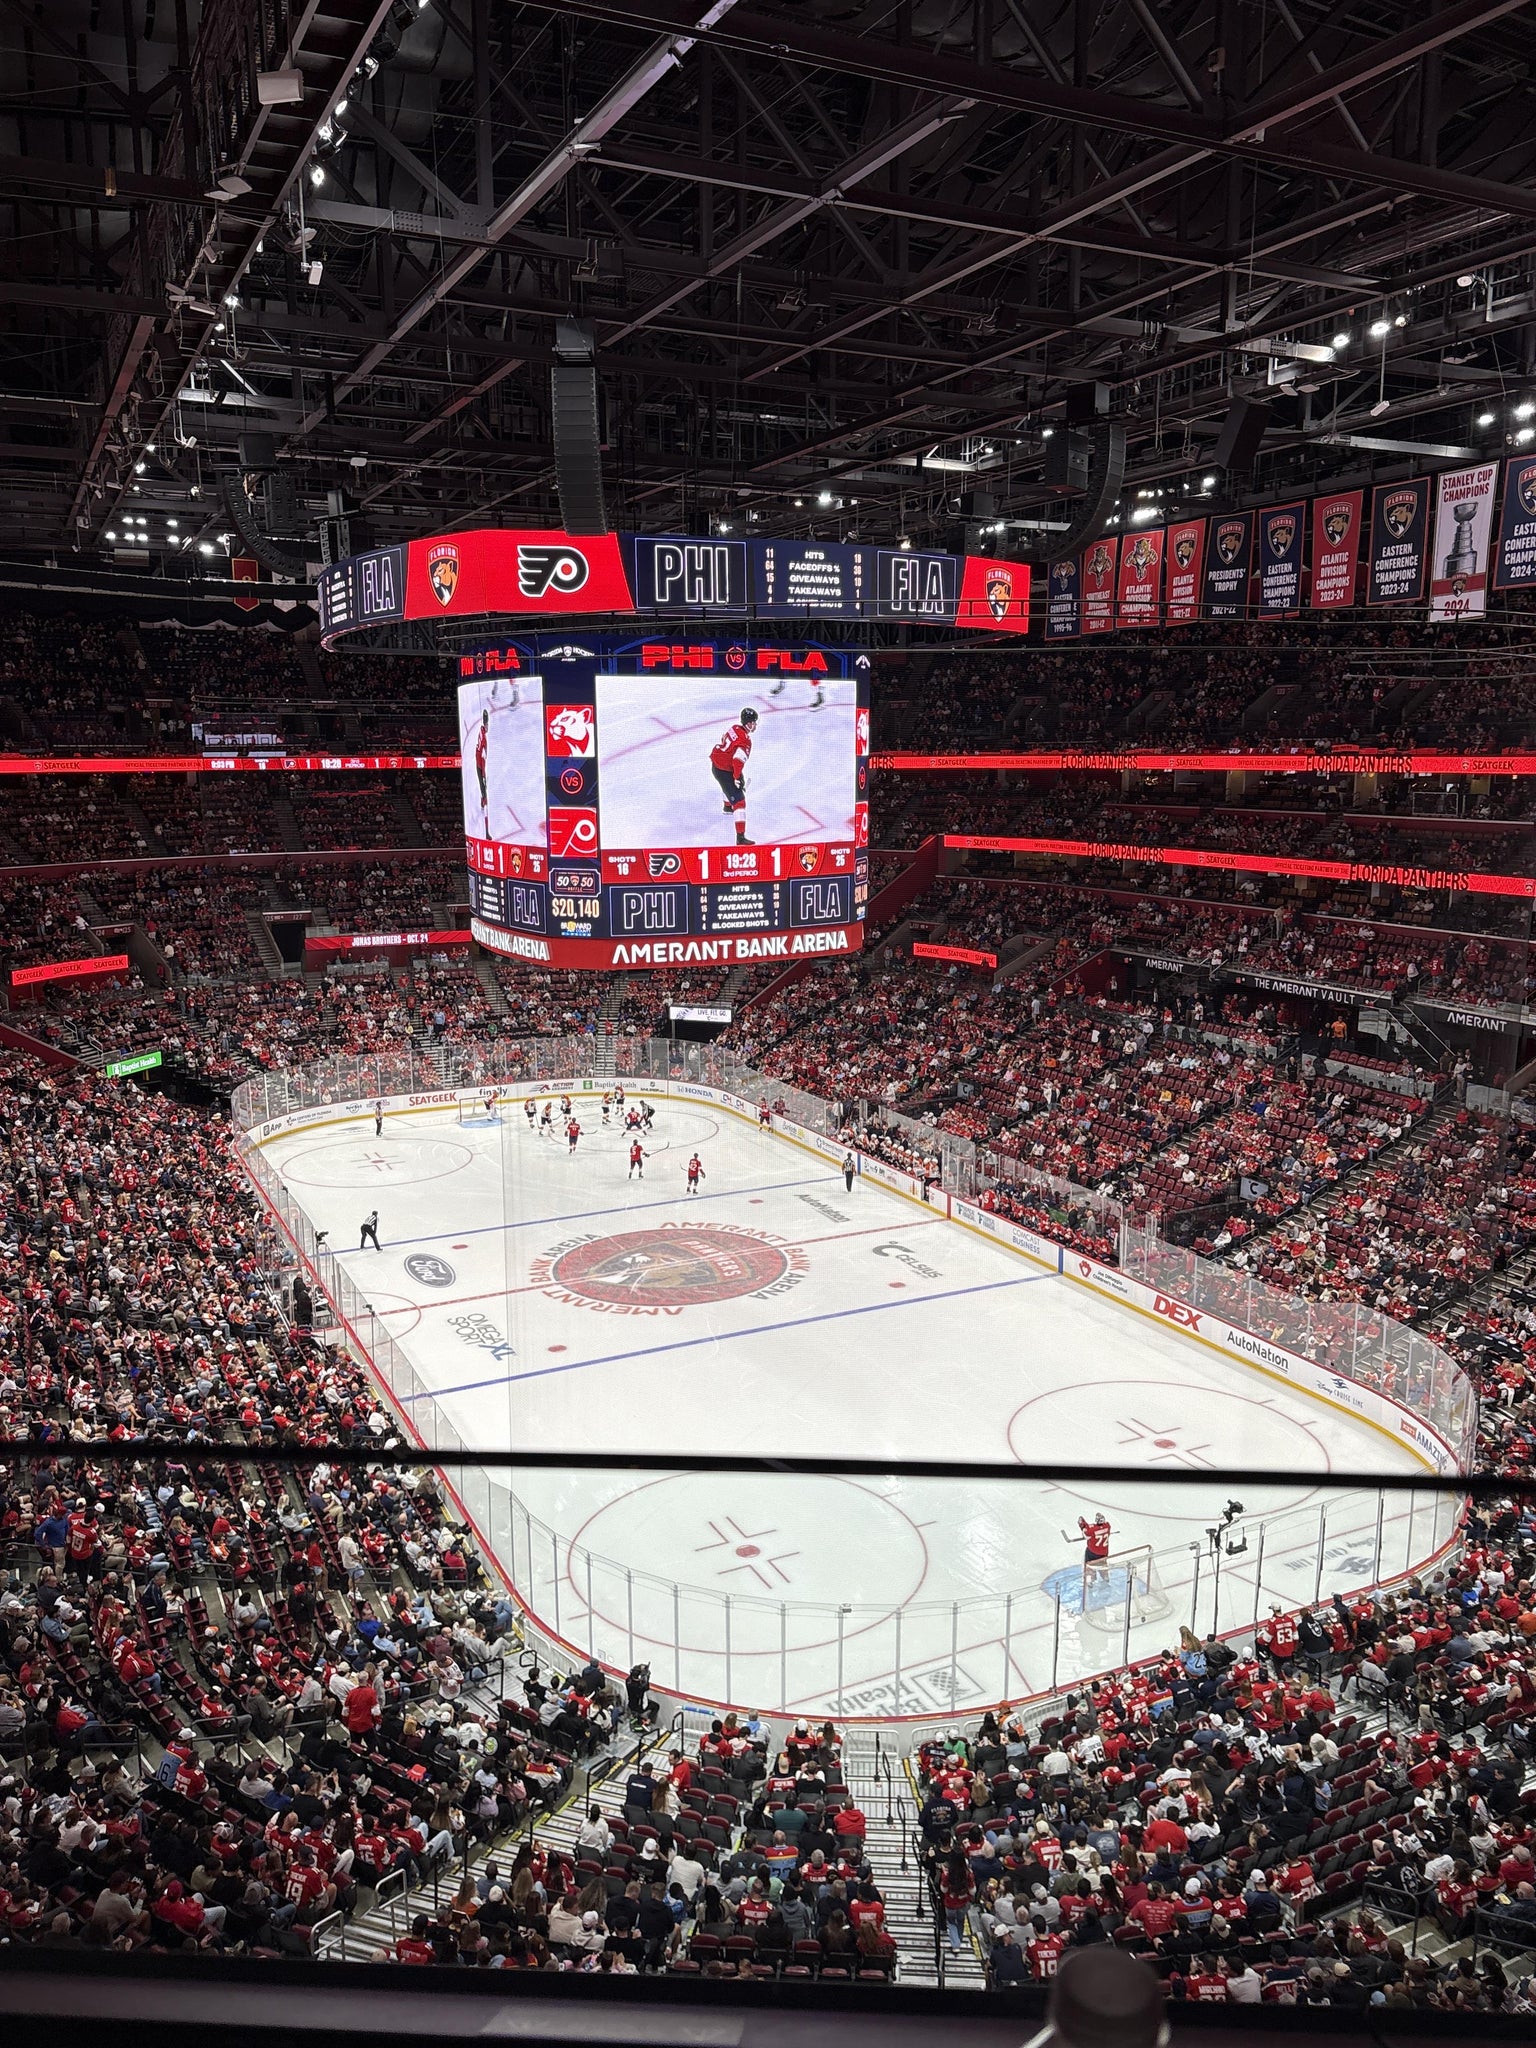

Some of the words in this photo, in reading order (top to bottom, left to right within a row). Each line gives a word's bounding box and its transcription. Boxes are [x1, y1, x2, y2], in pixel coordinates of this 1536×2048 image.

[1443, 473, 1476, 490] STANLEY
[1477, 469, 1493, 482] CUP
[1443, 483, 1490, 503] CHAMPIONS
[804, 551, 825, 561] HITS
[1382, 543, 1413, 558] EASTERN
[1320, 552, 1349, 566] ATLANTIC
[1375, 555, 1419, 571] CONFERENCE
[654, 544, 730, 604] PHI
[789, 562, 833, 573] FACEOFFS
[1208, 568, 1246, 581] PRESIDENTS'
[1267, 562, 1293, 575] EASTERN
[1320, 564, 1348, 578] DIVISION
[789, 574, 840, 585] GIVEAWAYS
[1172, 573, 1195, 586] ATLANTIC
[1262, 573, 1297, 588] CONFERENCE
[1316, 576, 1350, 591] CHAMPIONS
[1375, 568, 1417, 584] CHAMPIONS
[362, 557, 396, 615] FLA
[788, 586, 842, 597] TAKEAWAYS
[891, 557, 944, 614] FLA
[1172, 585, 1194, 598] DIVISION
[1214, 581, 1238, 593] TROPHY
[1263, 585, 1296, 599] CHAMPIONS
[1380, 582, 1410, 596] 2023-24
[1267, 597, 1291, 608] 2022-23
[1320, 590, 1344, 602] 2023-24
[1443, 598, 1470, 617] 2024
[485, 647, 520, 672] FLA
[642, 645, 714, 669] PHI
[729, 653, 742, 664] VS
[756, 648, 829, 672] FLA
[44, 762, 80, 770] SEATGEEK
[1062, 755, 1096, 770] FLORIDA
[1099, 755, 1137, 770] PANTHERS
[1306, 756, 1350, 772] FLORIDA
[1353, 756, 1412, 772] PANTHERS
[1473, 760, 1514, 770] SEATGEEK
[565, 776, 579, 788] VS
[1087, 843, 1119, 858] FLORIDA
[1121, 846, 1164, 862] PANTHERS
[1206, 855, 1236, 865] SEATGEEK
[698, 850, 709, 880] 1
[726, 853, 757, 869] 19:28
[771, 847, 781, 877] 1
[556, 876, 569, 887] 50
[580, 877, 594, 888] 50
[1350, 864, 1398, 885] FLORIDA
[1400, 869, 1469, 890] PANTHERS
[513, 886, 540, 926] FLA
[718, 894, 757, 902] FACEOFFS
[801, 884, 841, 919] FLA
[552, 898, 600, 919] $20,140
[623, 892, 676, 930] PHI
[717, 911, 765, 919] TAKEAWAYS
[718, 903, 763, 911] GIVEAWAYS
[712, 922, 745, 930] BLOCKED
[745, 920, 769, 928] SHOTS
[352, 936, 371, 946] JONAS
[371, 934, 402, 945] BROTHERS
[512, 935, 550, 960] ARENA
[612, 940, 732, 964] AMERANT
[736, 936, 788, 958] BANK
[791, 930, 848, 953] ARENA
[54, 964, 82, 974] SEATGEEK
[94, 959, 124, 969] SEATGEEK
[1146, 959, 1183, 973] AMERANT
[16, 970, 44, 981] SEATGEEK
[1254, 977, 1270, 989] THE
[1272, 981, 1318, 998] AMERANT
[1321, 989, 1356, 1005] VAULT
[1447, 1011, 1508, 1032] AMERANT
[122, 1061, 139, 1072] Baptist
[140, 1056, 156, 1069] Health
[409, 1092, 457, 1106] SEATGEEK
[685, 1088, 713, 1098] HONDA
[660, 1221, 788, 1243] AMERANT
[543, 1233, 603, 1258] ARENA
[784, 1248, 810, 1272] BANK
[895, 1254, 944, 1279] CELSIUS
[528, 1258, 552, 1283] BANK
[748, 1272, 806, 1300] ARENA
[543, 1290, 685, 1317] AMERANT
[1153, 1295, 1203, 1332] DEX
[447, 1316, 486, 1345] SPORT
[467, 1313, 505, 1345] OMEGA
[1227, 1331, 1289, 1371] AutoNation
[1095, 1533, 1109, 1547] 72
[1277, 1628, 1293, 1644] 63
[826, 1681, 914, 1715] Health
[285, 1880, 303, 1907] 19
